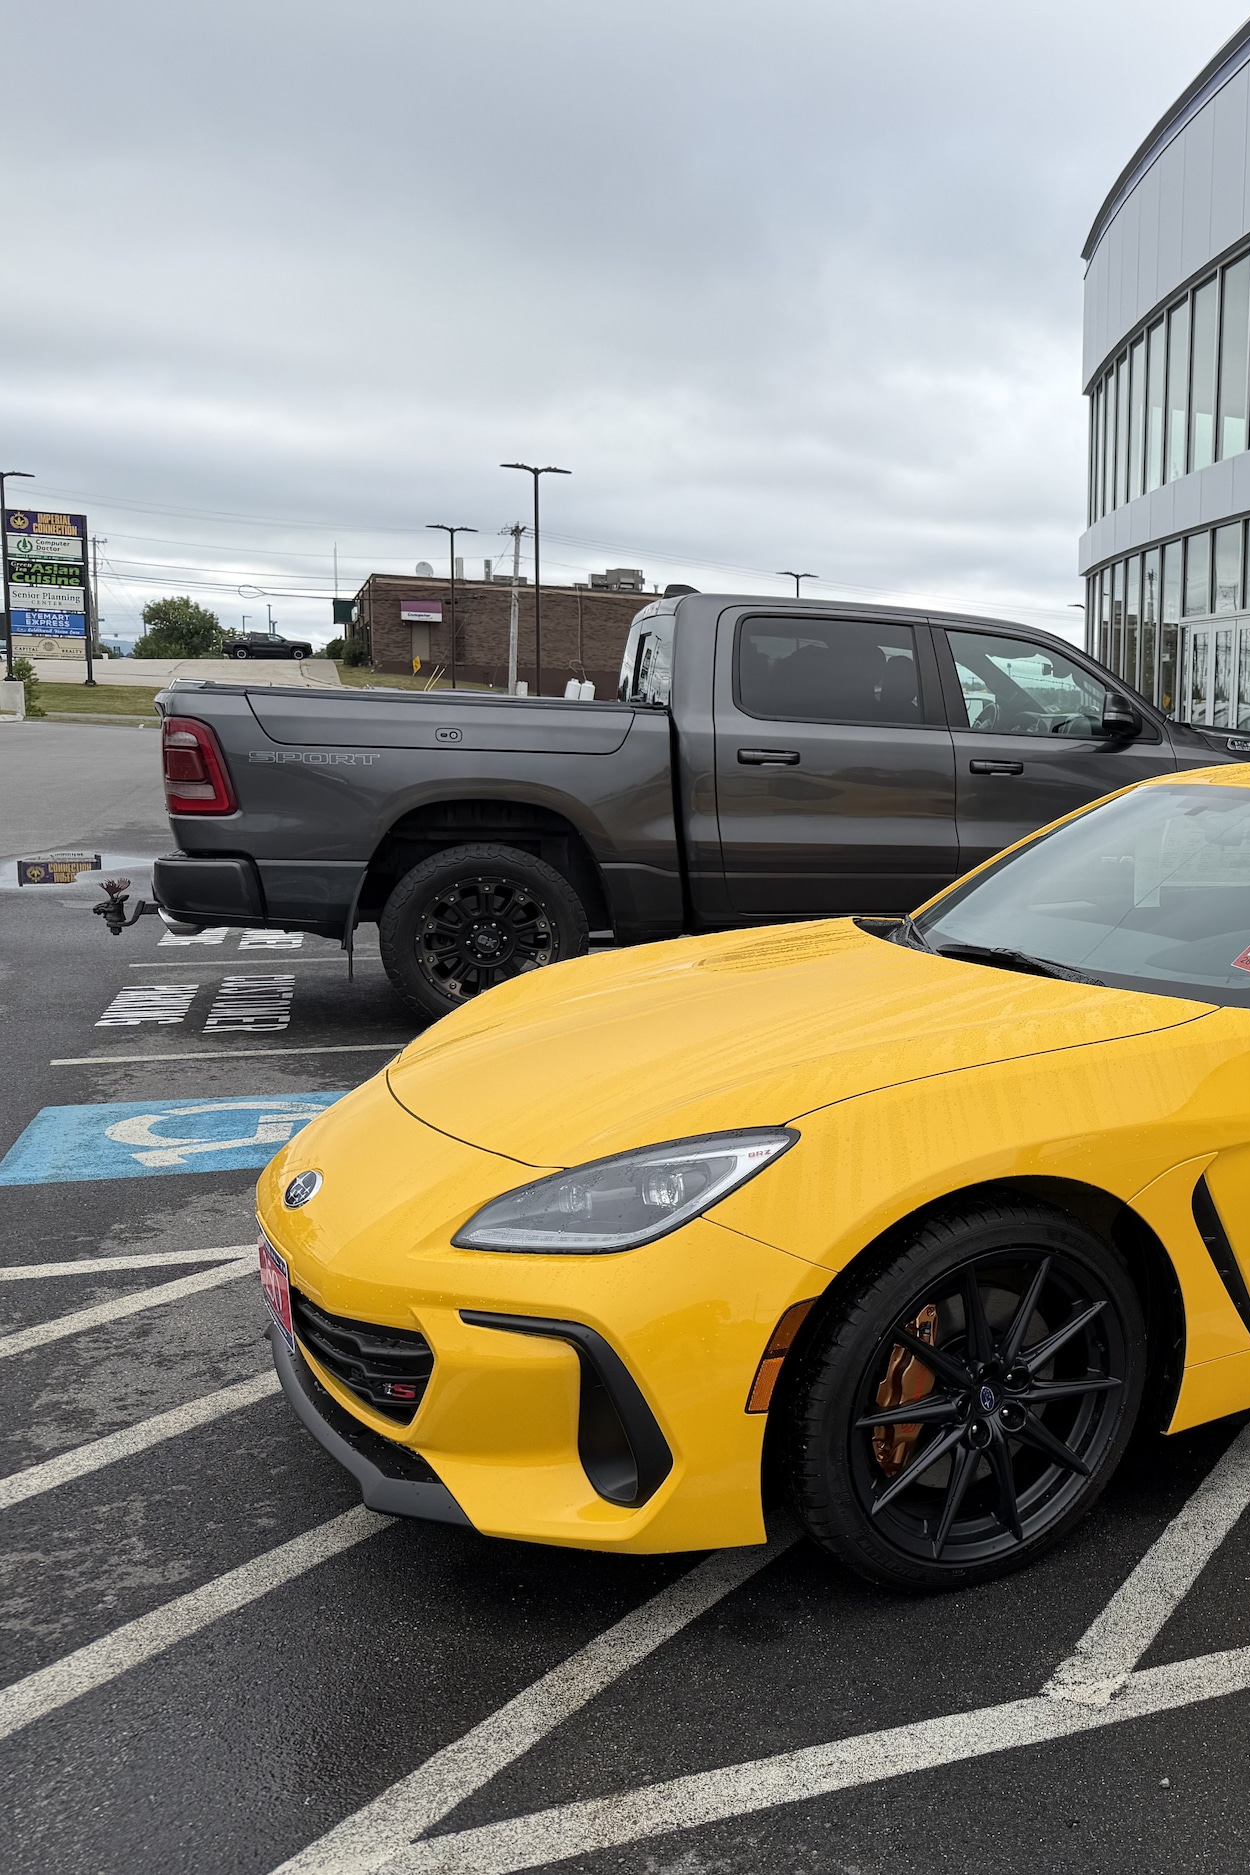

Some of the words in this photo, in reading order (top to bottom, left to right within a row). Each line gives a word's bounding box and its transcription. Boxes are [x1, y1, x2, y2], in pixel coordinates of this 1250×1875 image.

[37, 513, 71, 525] IMPERIAL
[33, 523, 78, 536] CONNECTION
[35, 539, 70, 547] Computer
[30, 563, 80, 576] Asian
[11, 572, 80, 586] Cuisine
[12, 590, 40, 599] Senior
[42, 592, 81, 604] Planning
[25, 612, 70, 621] EYEMART
[25, 619, 70, 628] EXPRESS
[248, 751, 381, 766] SPORT
[94, 984, 200, 1027] PARKING
[202, 974, 296, 1034] CUSTOMER
[748, 1149, 771, 1158] BRZ
